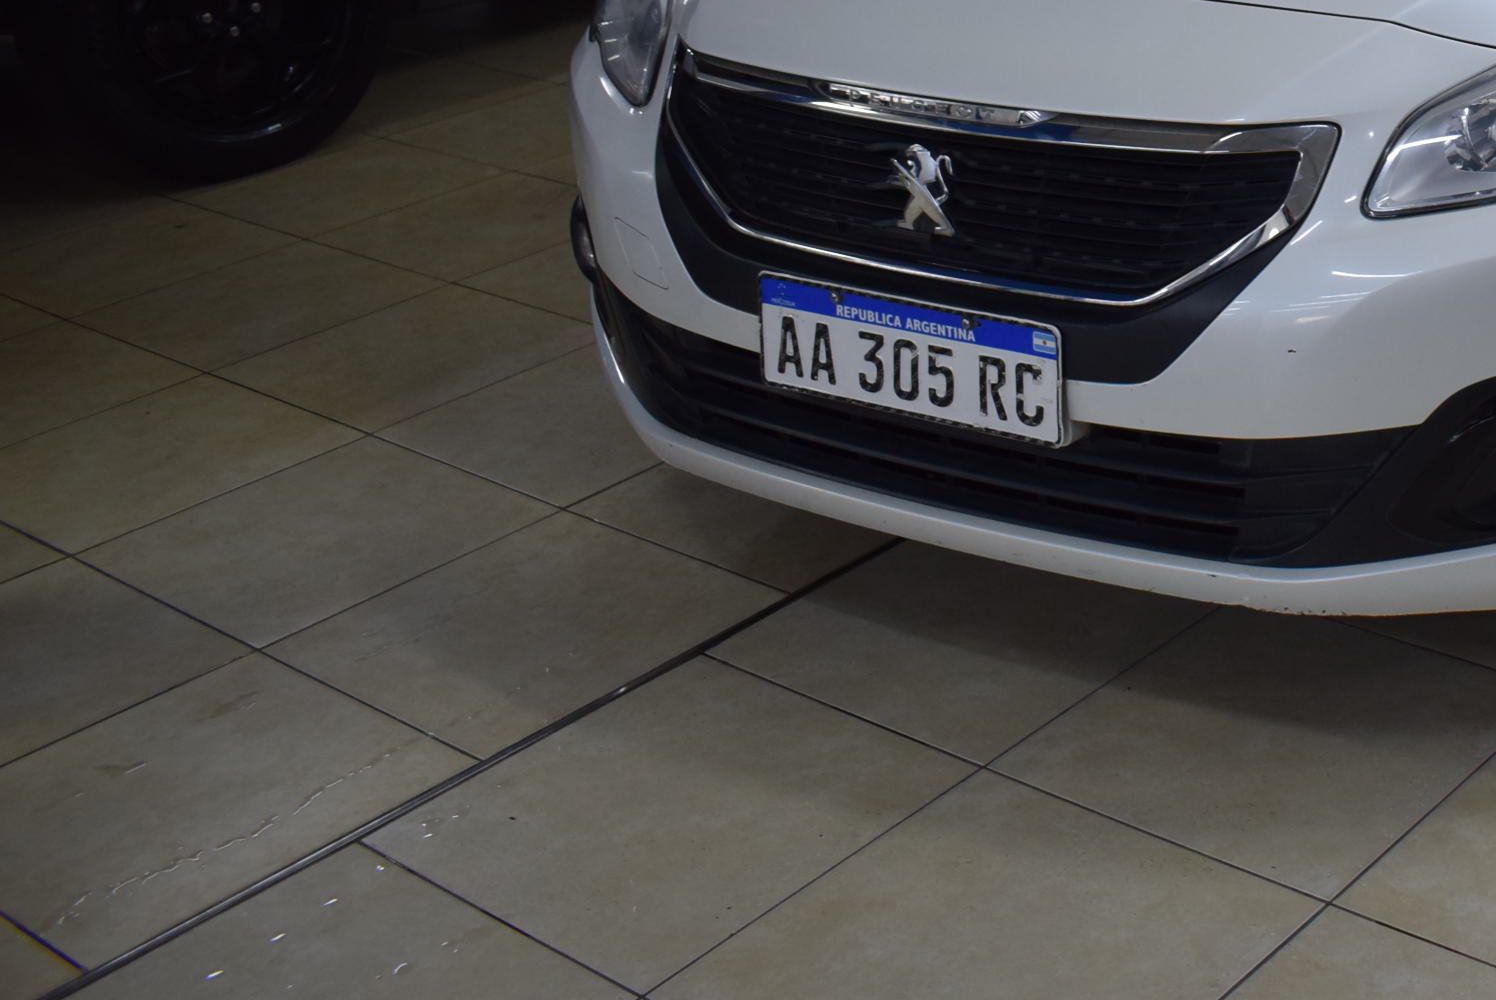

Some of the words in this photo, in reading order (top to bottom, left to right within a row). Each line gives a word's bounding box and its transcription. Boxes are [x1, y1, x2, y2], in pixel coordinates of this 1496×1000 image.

[847, 88, 996, 120] PEUGEOT
[835, 304, 902, 328] REPUBLICA
[905, 317, 976, 343] ARGENTINA
[777, 316, 837, 386] AA
[857, 330, 955, 409] 305
[978, 354, 1045, 428] RC
